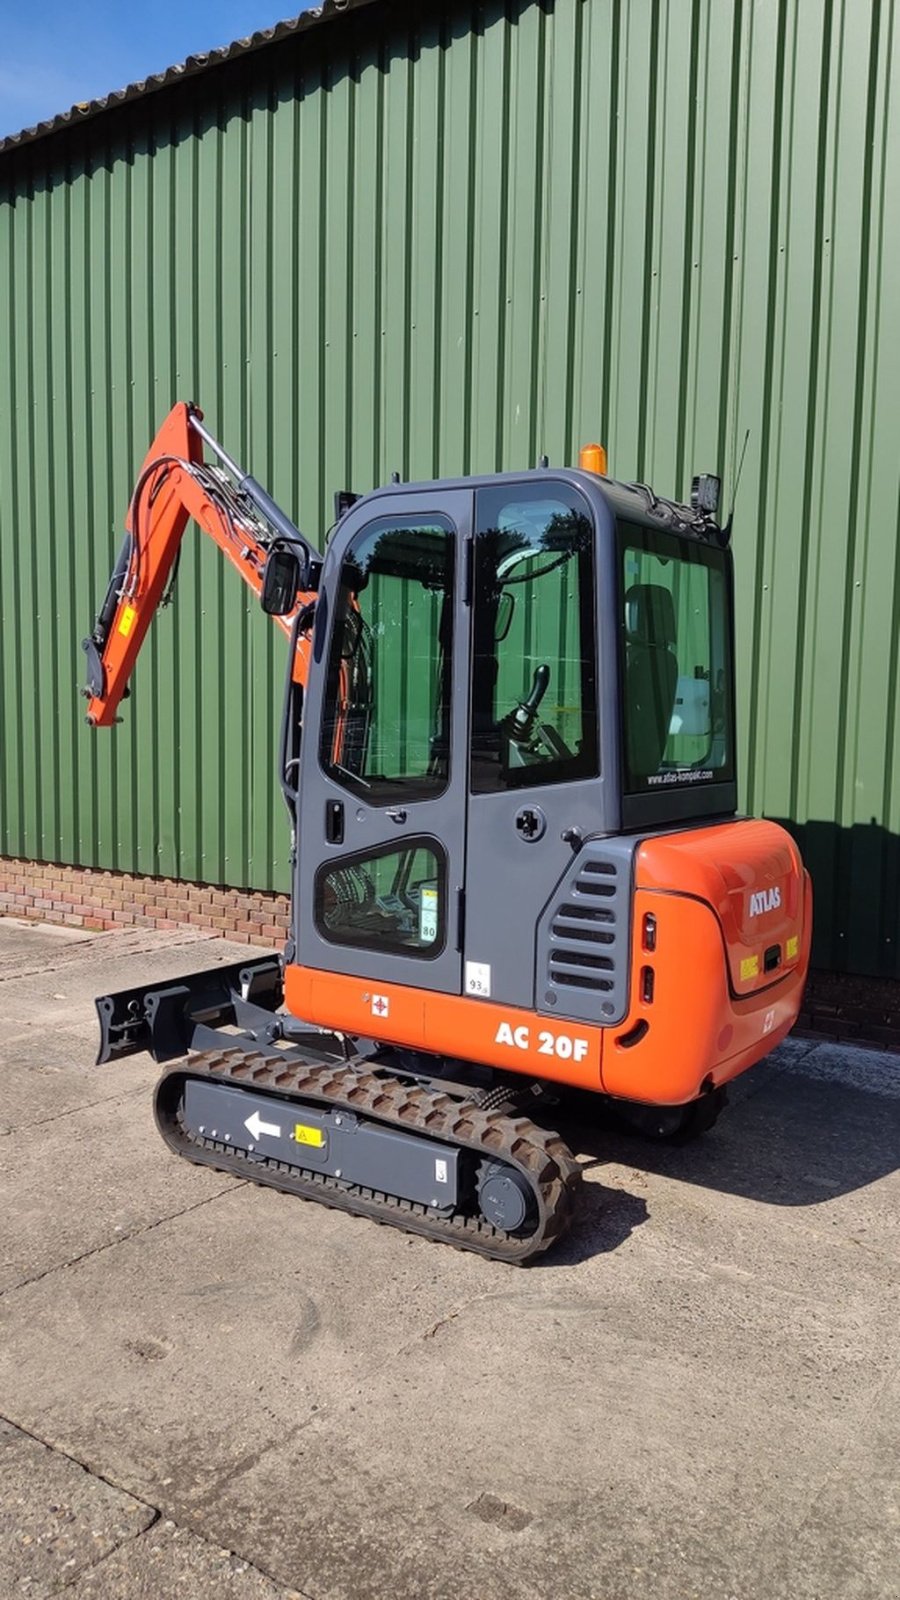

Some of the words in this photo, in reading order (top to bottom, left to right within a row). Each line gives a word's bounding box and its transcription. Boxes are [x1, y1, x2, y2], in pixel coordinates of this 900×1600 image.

[749, 886, 781, 917] ATLAS
[423, 926, 435, 937] 80
[470, 979, 482, 991] 93
[494, 1021, 529, 1049] AC
[537, 1031, 588, 1062] 20F
